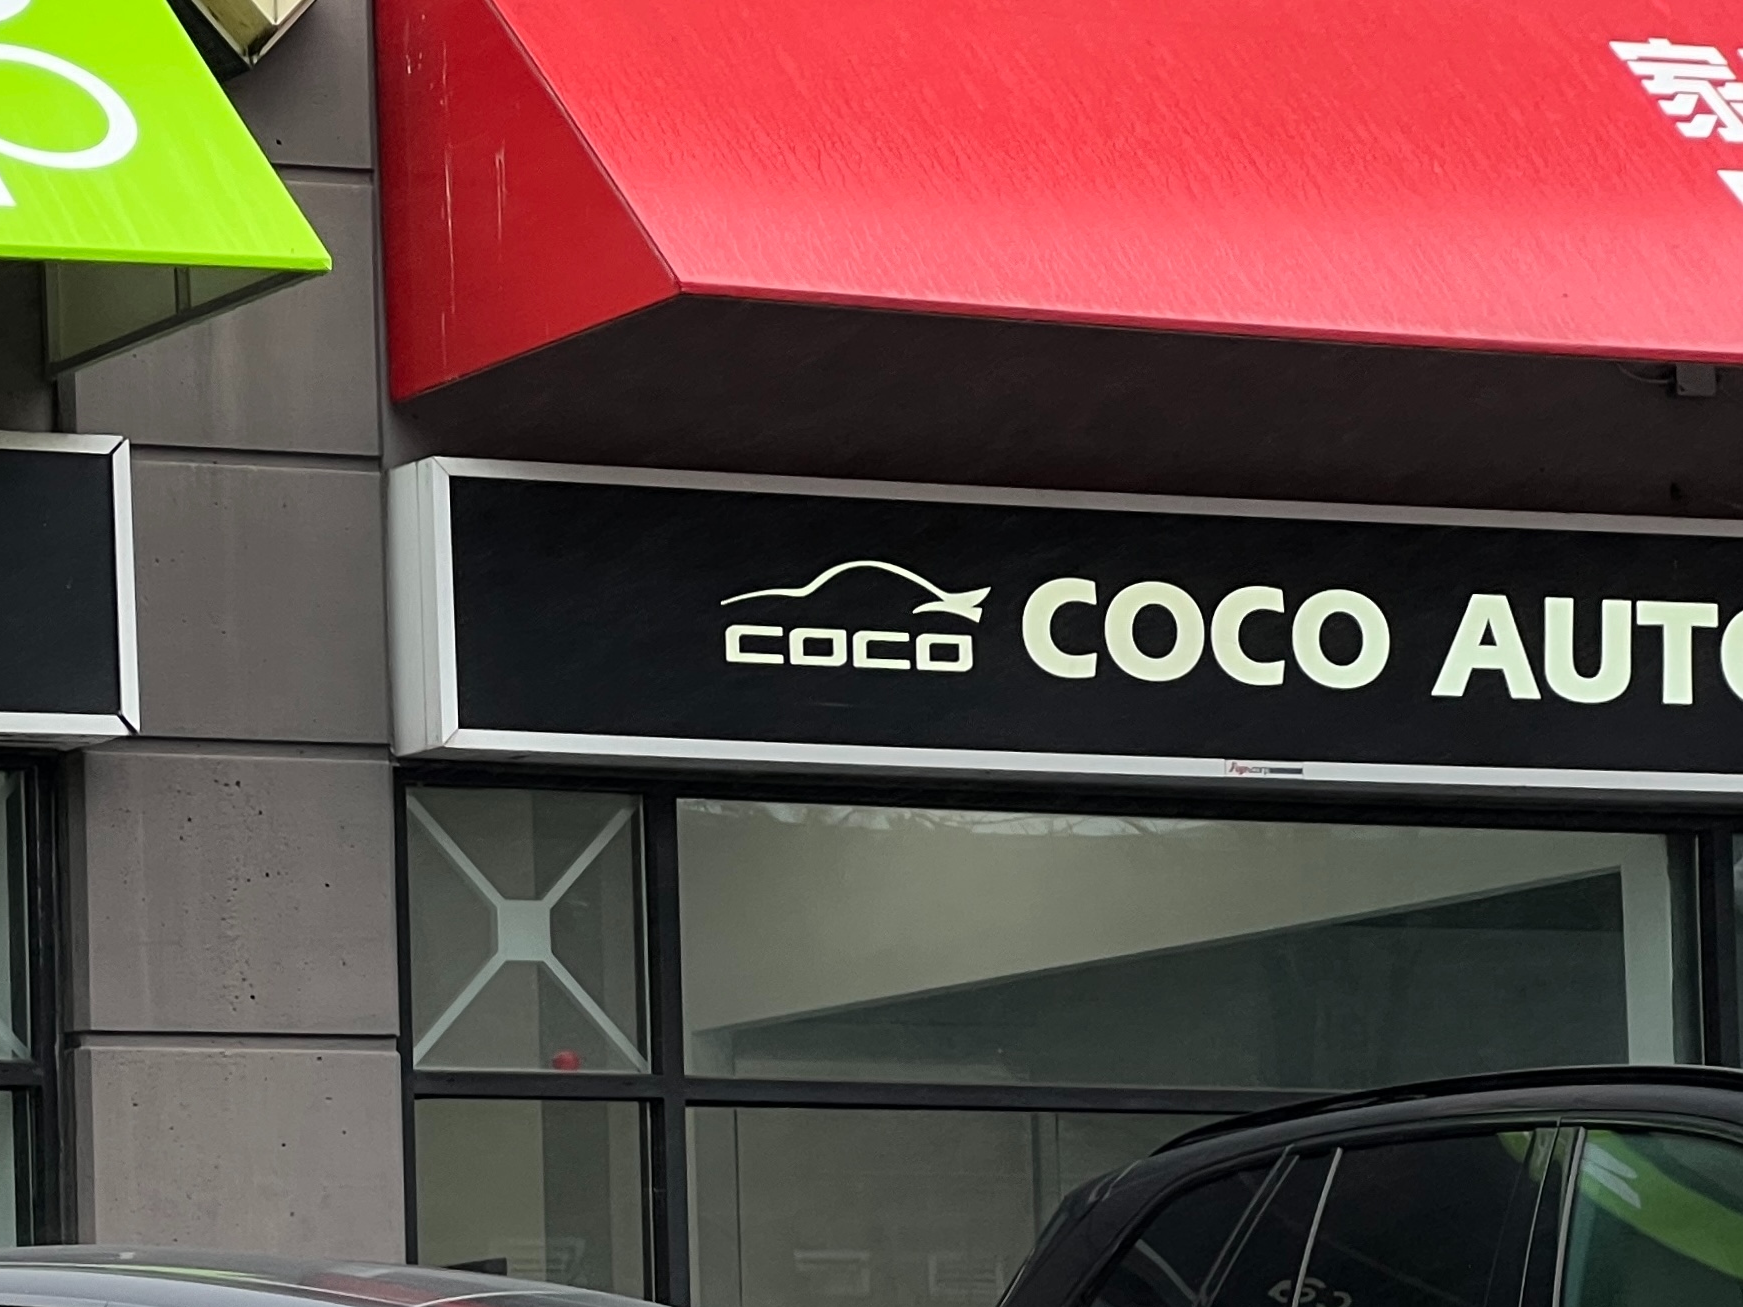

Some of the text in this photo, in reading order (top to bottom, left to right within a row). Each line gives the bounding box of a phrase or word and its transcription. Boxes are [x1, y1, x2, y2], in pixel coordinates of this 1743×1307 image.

[1609, 37, 1743, 142] 家
[1023, 578, 1743, 705] COCO AUT
